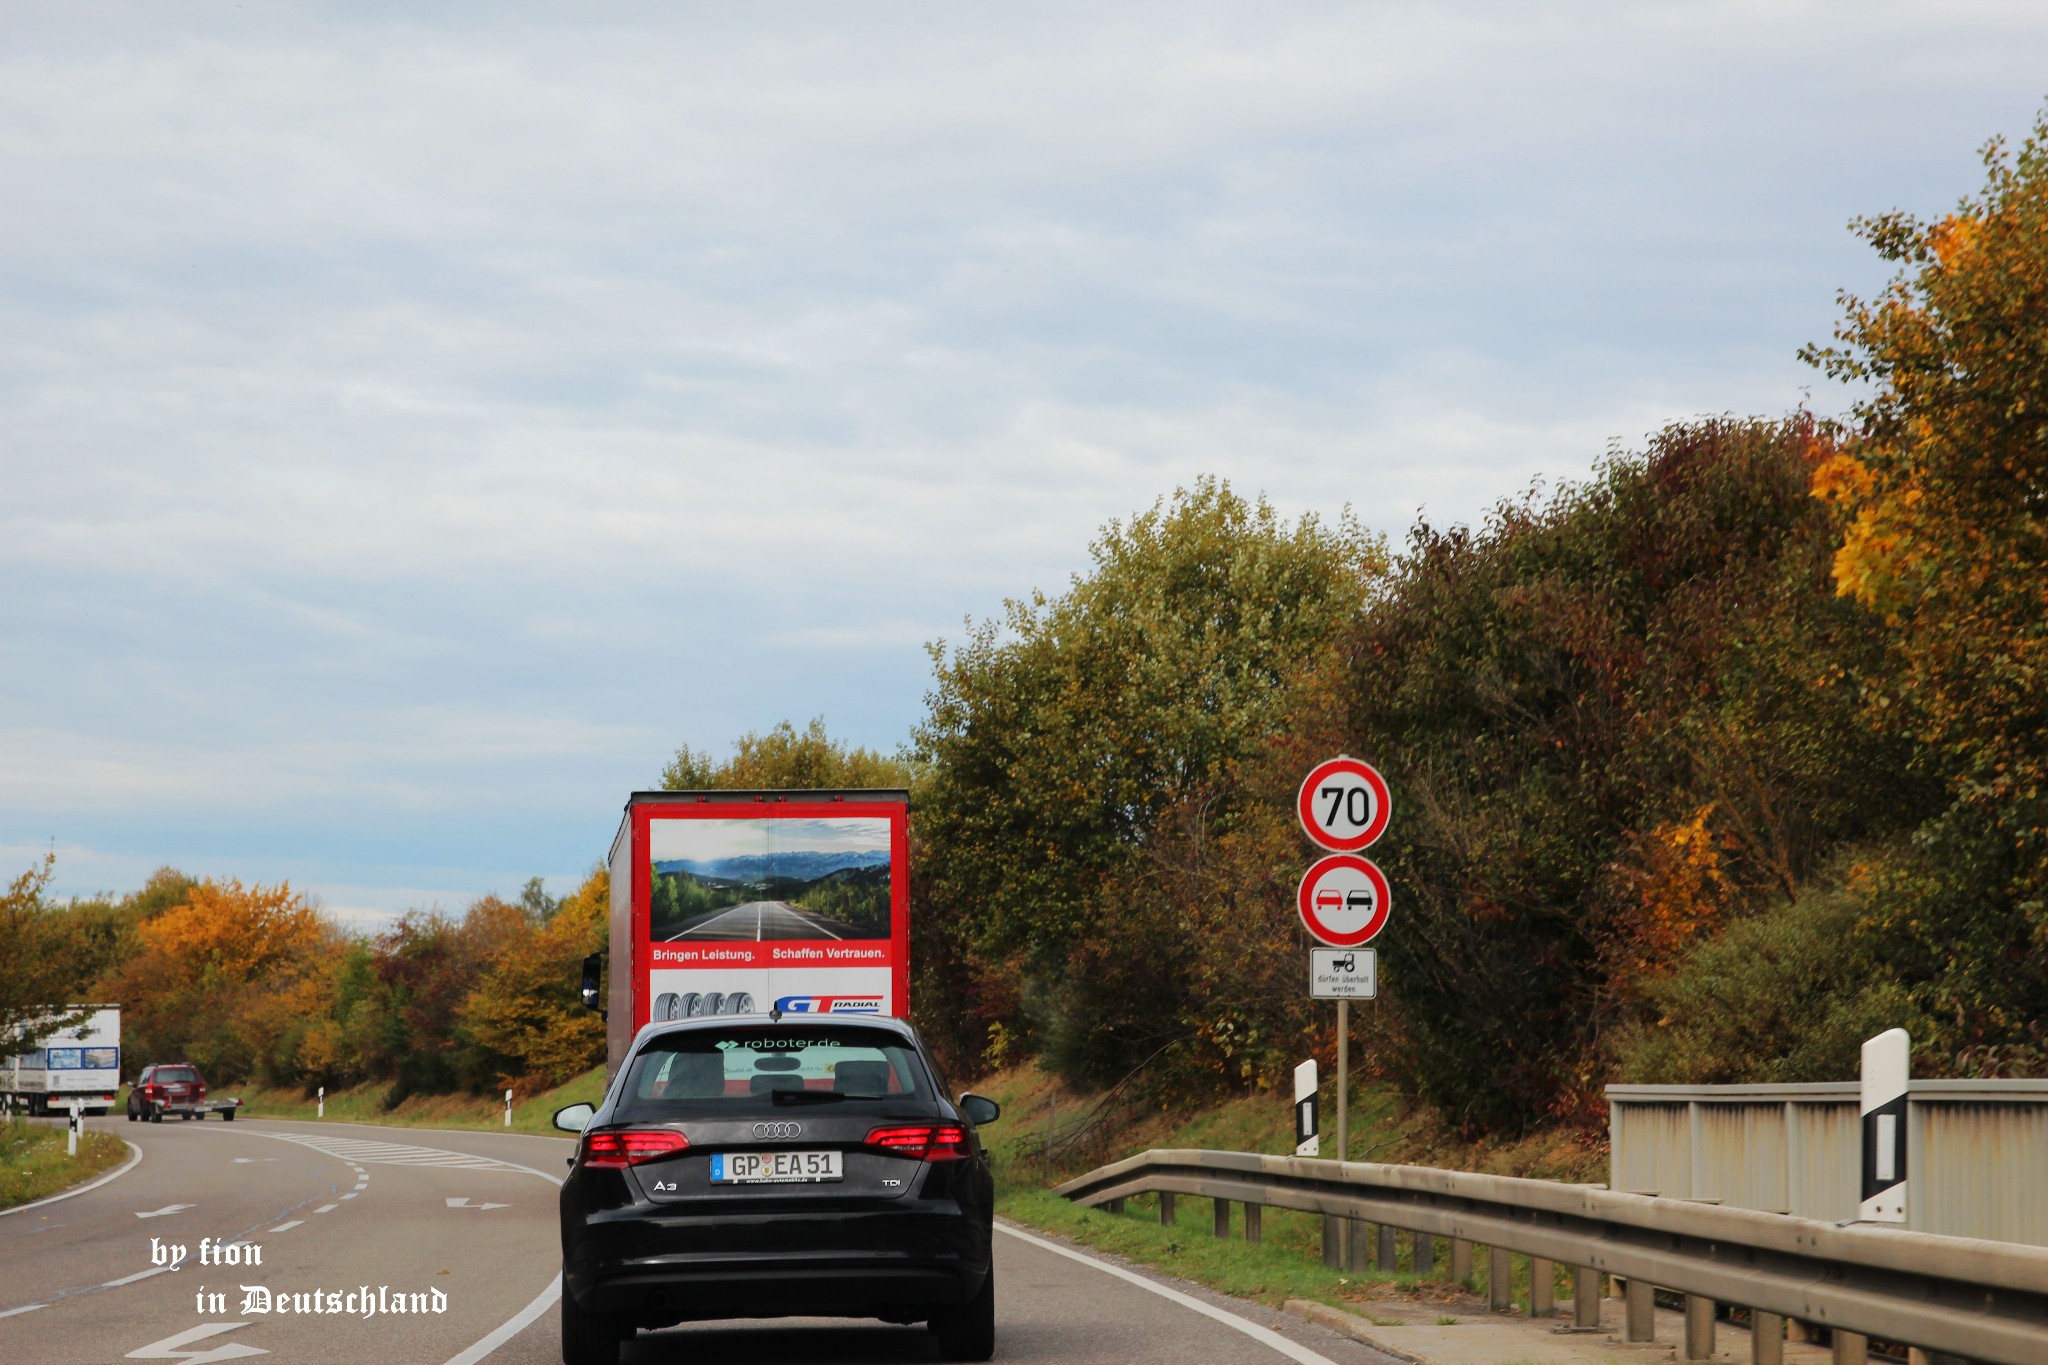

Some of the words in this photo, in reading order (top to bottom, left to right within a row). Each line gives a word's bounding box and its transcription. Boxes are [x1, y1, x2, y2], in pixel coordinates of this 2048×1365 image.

[1321, 787, 1369, 827] 70
[653, 950, 698, 963] Bringen
[702, 949, 755, 963] Leistung.
[773, 948, 823, 959] Schaffen
[826, 948, 885, 959] Vertrauen.
[1317, 974, 1339, 983] dürfen
[1342, 975, 1369, 984] überholt
[1332, 985, 1356, 993] werden
[744, 1038, 840, 1048] roboter.de
[732, 1155, 760, 1176] GP
[653, 1181, 677, 1191] A3
[882, 1179, 901, 1187] TDI
